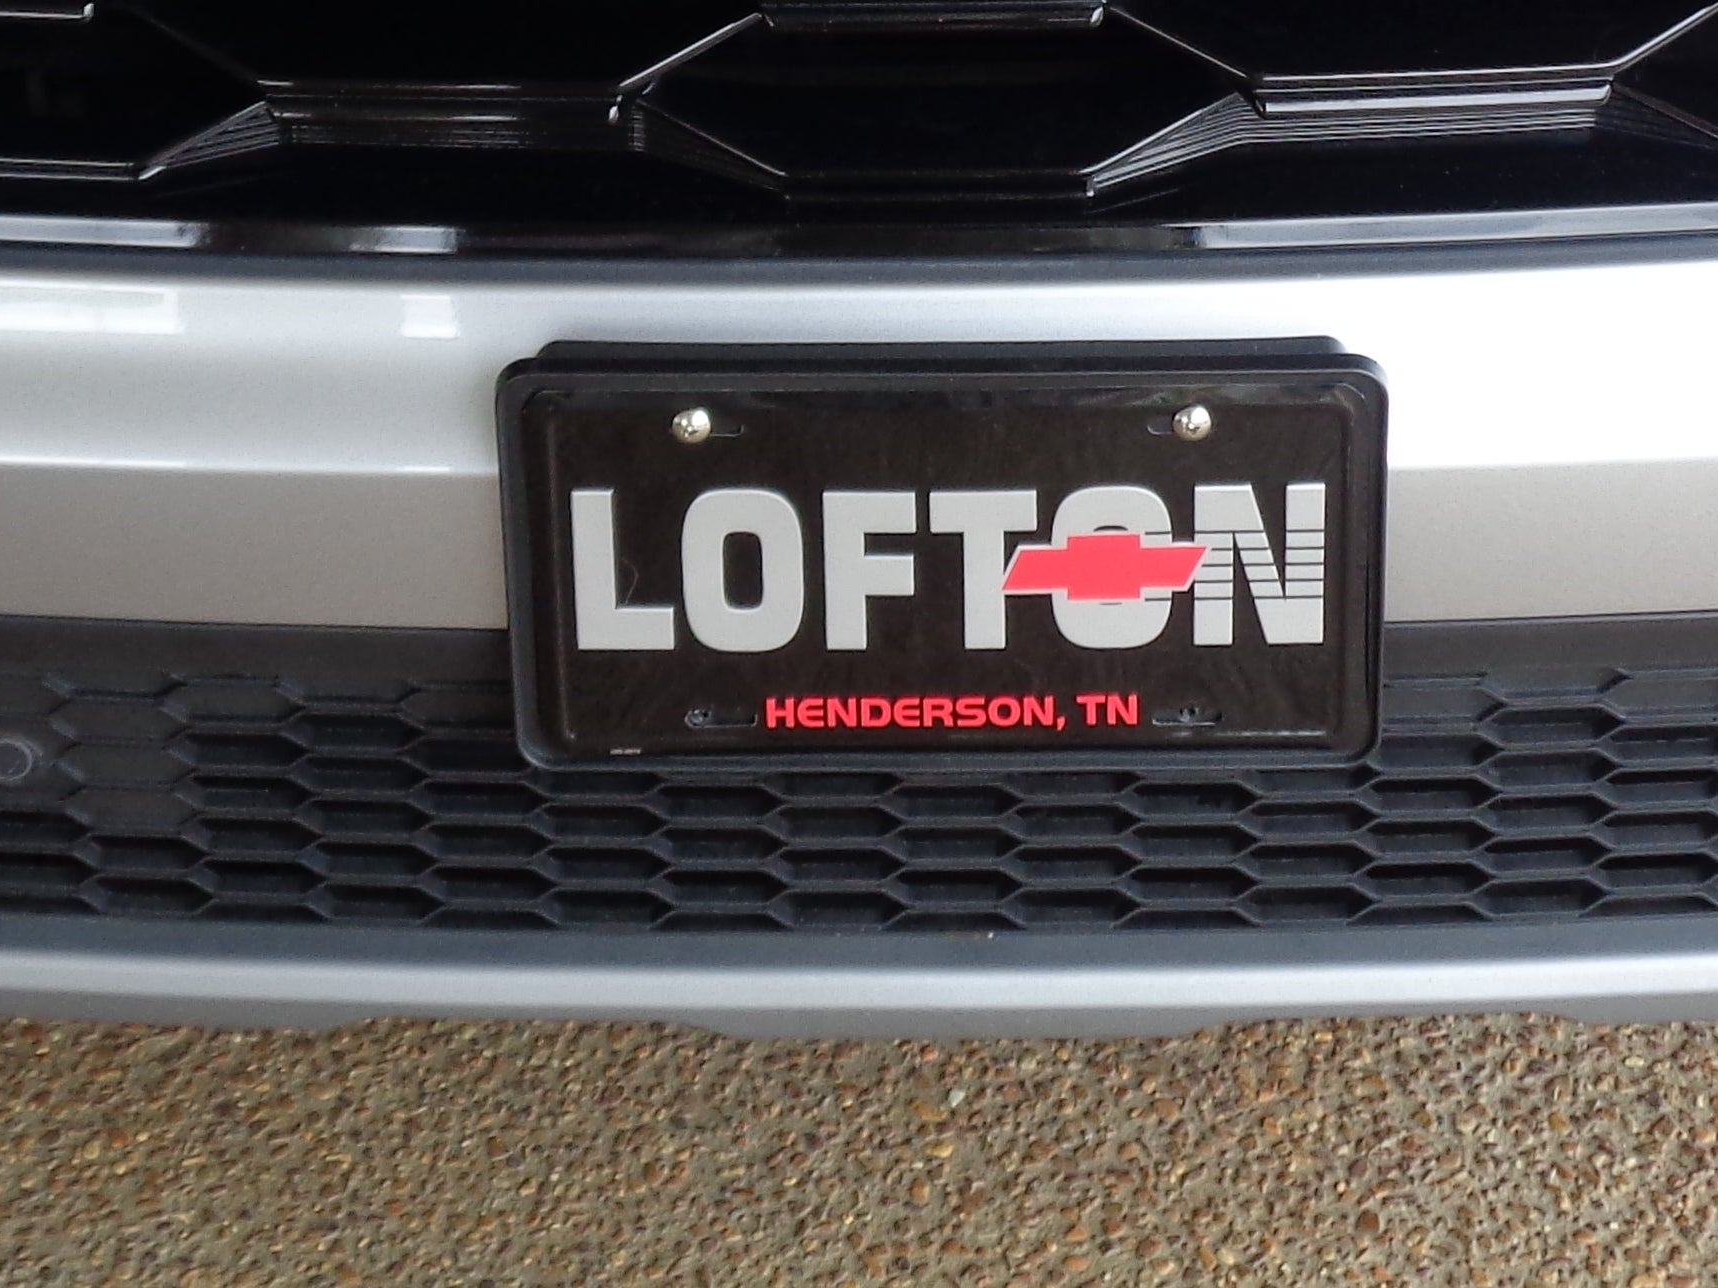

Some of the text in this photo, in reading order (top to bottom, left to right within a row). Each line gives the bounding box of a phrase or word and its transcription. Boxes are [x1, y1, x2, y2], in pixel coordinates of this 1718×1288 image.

[569, 480, 1327, 654] LOFTON
[765, 693, 1138, 732] HENDERSON, TN
